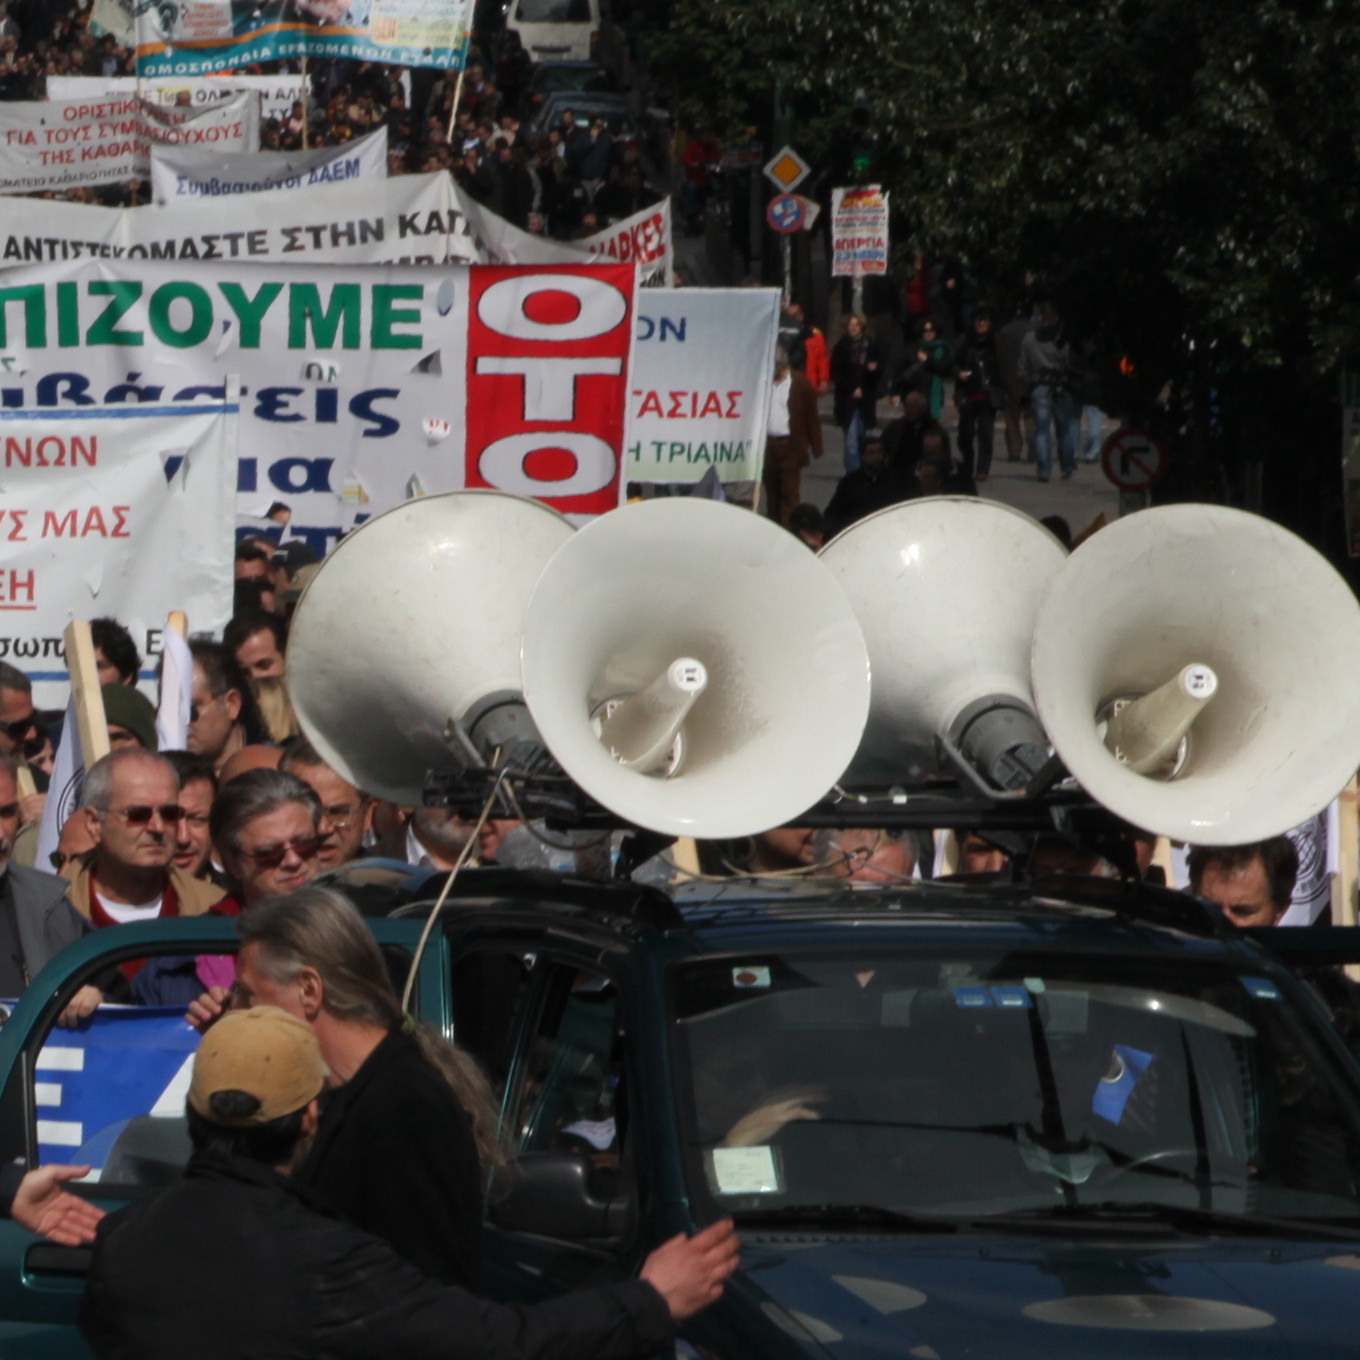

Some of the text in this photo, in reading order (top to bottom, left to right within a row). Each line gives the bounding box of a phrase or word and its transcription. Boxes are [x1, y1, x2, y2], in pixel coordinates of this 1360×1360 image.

[144, 46, 272, 75] ΟΜΟΣΠΟΝΔΙΑ
[6, 129, 38, 146] ΓΙΑ
[44, 124, 92, 145] ΤΟΥΣ
[39, 148, 76, 167] ΤΗΣ
[307, 157, 360, 185] ΔΑΕΜ
[281, 217, 385, 255] ΣΤΗΝ
[41, 505, 132, 539] ΜΑΣ
